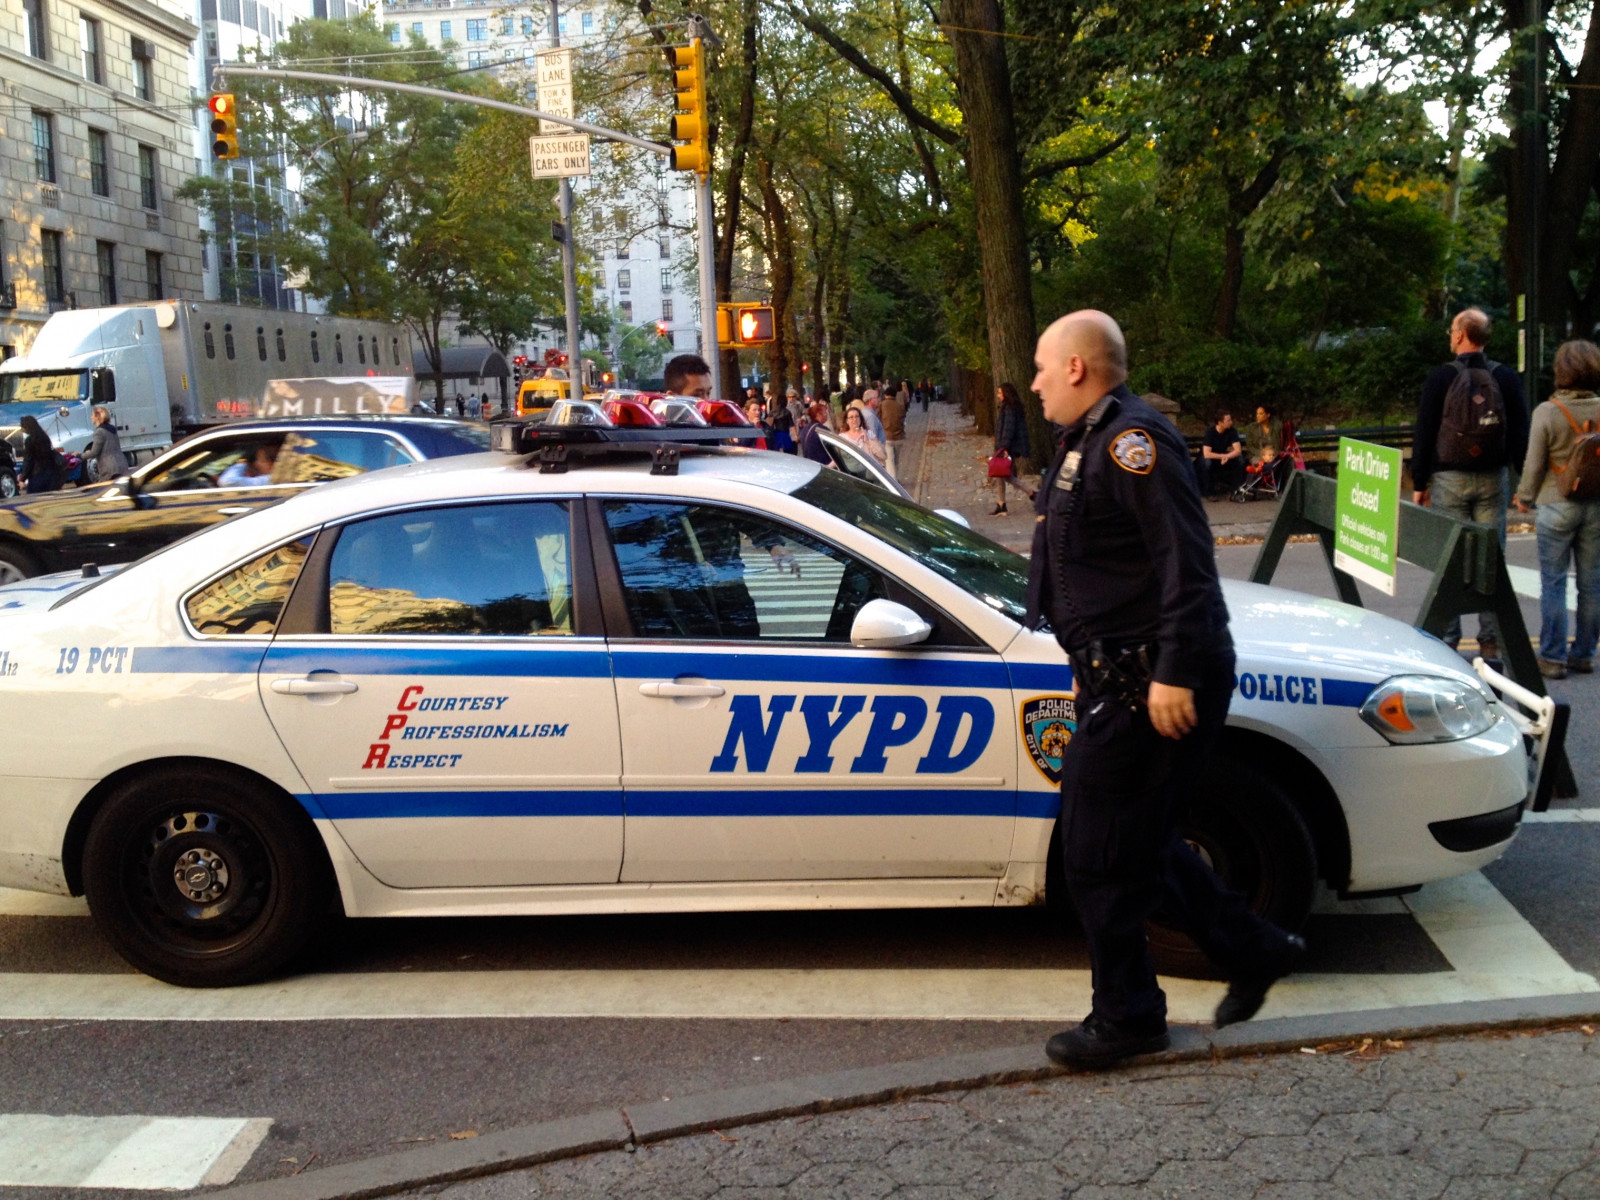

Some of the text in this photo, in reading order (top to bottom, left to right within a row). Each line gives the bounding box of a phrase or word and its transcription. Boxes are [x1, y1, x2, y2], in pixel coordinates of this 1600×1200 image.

[544, 54, 562, 66] BUS
[542, 68, 566, 82] LANE
[543, 88, 567, 98] TOW &
[547, 98, 563, 106] FINE
[544, 122, 566, 130] MINIMU
[535, 140, 585, 155] PASSENGER
[535, 157, 586, 170] CARS ONLY
[282, 395, 395, 416] MILLY
[1345, 446, 1390, 480] Park Drive
[1351, 482, 1380, 513] closed
[1339, 530, 1350, 547] Park
[1350, 536, 1365, 553] closes
[1357, 521, 1377, 540] vehicles
[1376, 530, 1388, 547] only
[56, 647, 128, 674] 19 PCT
[1038, 699, 1075, 711] POLICE
[1025, 708, 1077, 724] DEPARTME
[709, 694, 996, 774] NYPD
[1025, 733, 1048, 770] CITY OF
